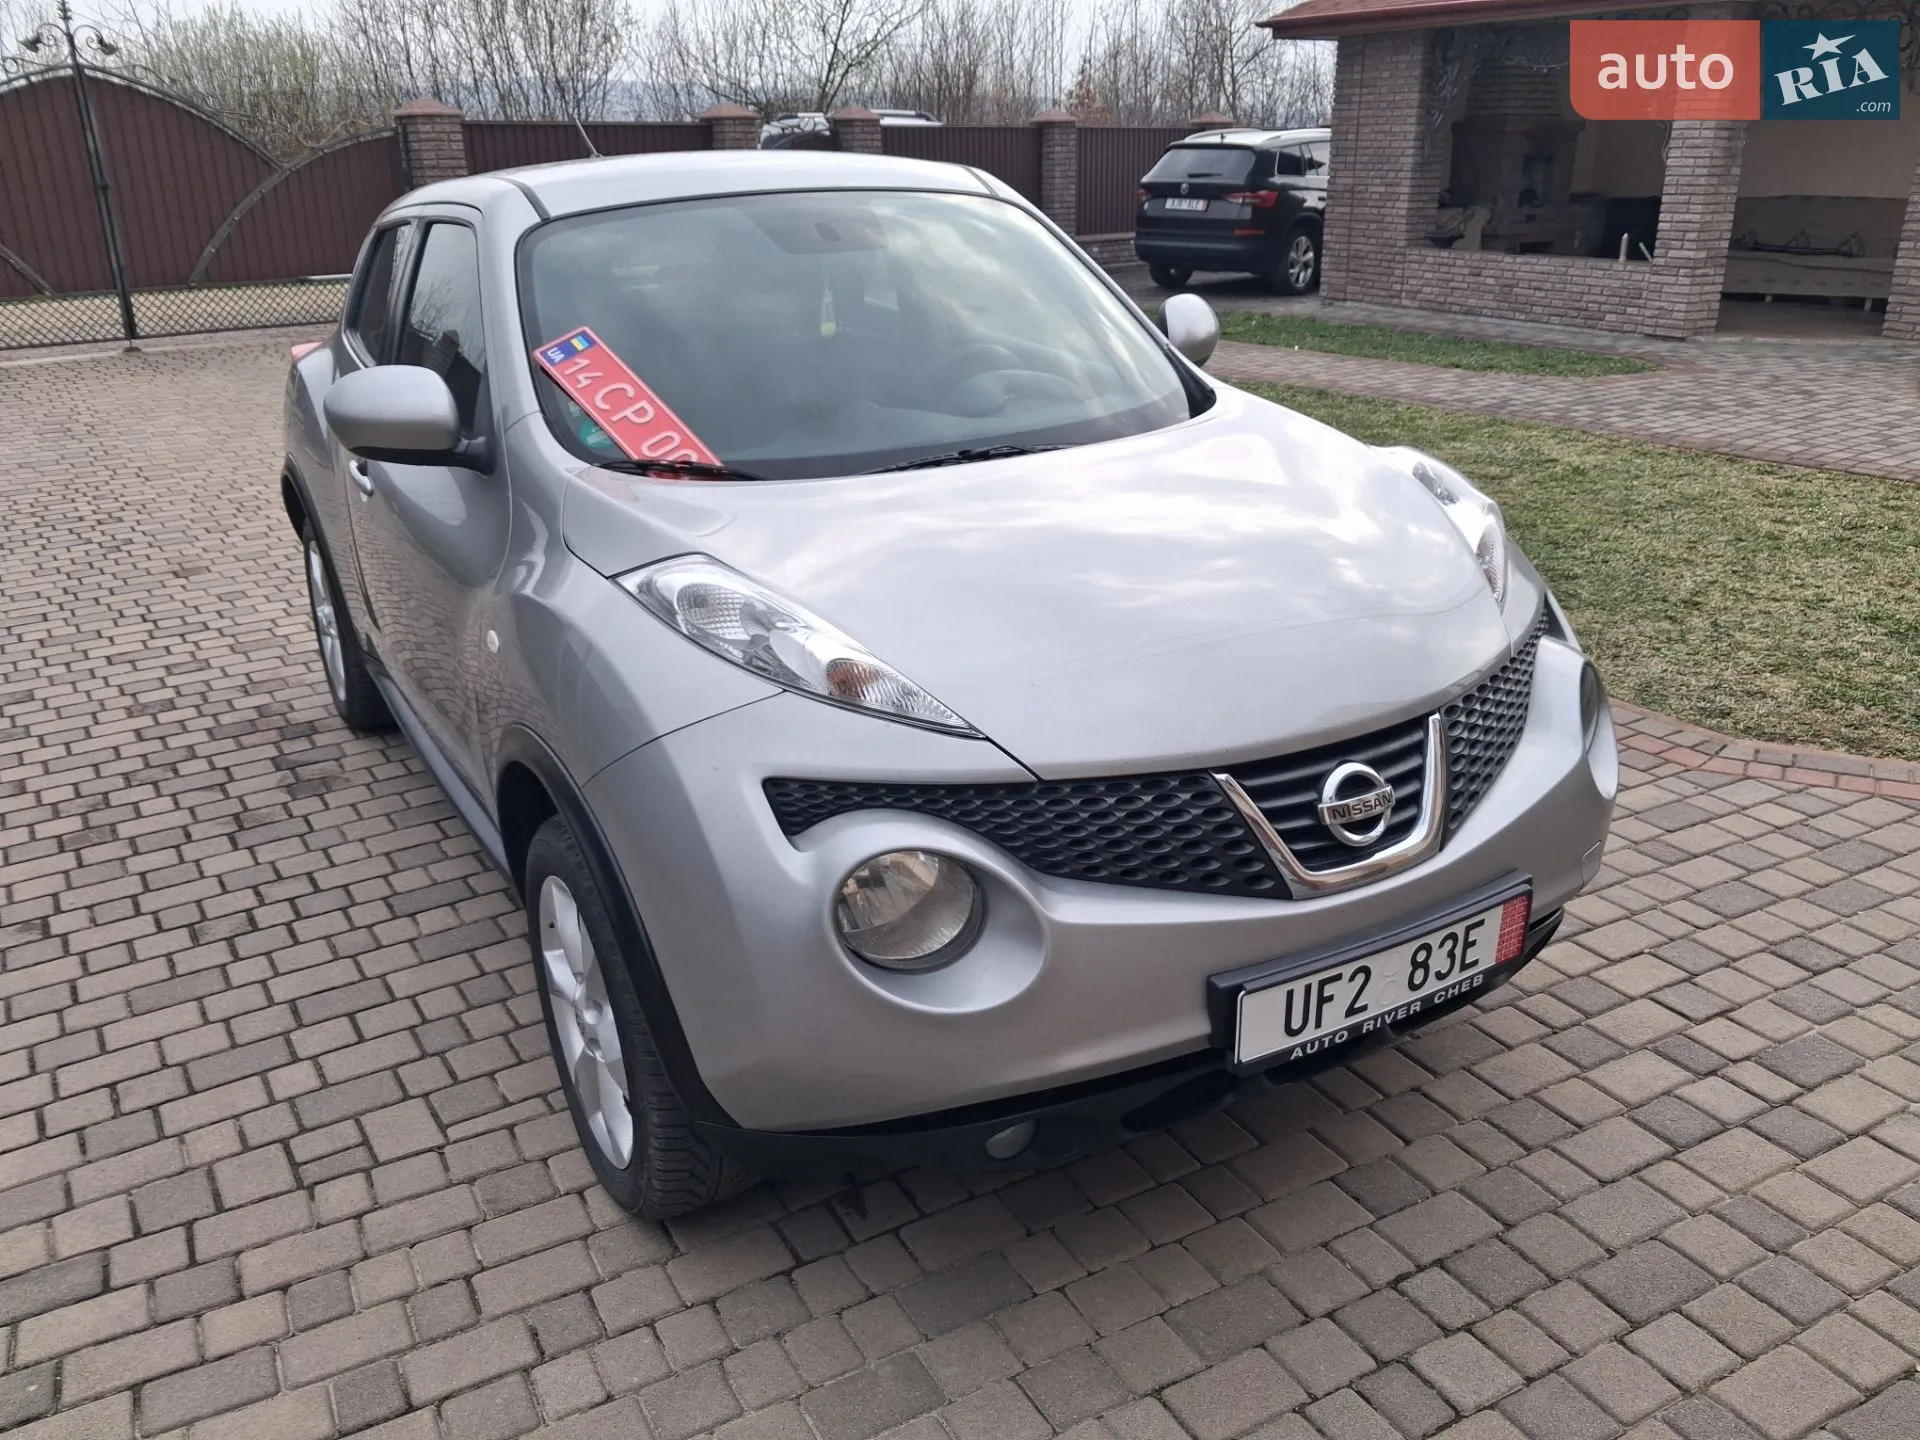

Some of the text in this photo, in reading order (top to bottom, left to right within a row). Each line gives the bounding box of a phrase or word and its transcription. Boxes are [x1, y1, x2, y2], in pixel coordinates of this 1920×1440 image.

[547, 347, 565, 363] UA
[563, 357, 603, 389] 14
[594, 382, 655, 424] CP
[1332, 794, 1393, 820] NISSAN
[1284, 918, 1485, 1037] UF2 83E
[1290, 973, 1483, 1060] AUTO RIVER CHEB
